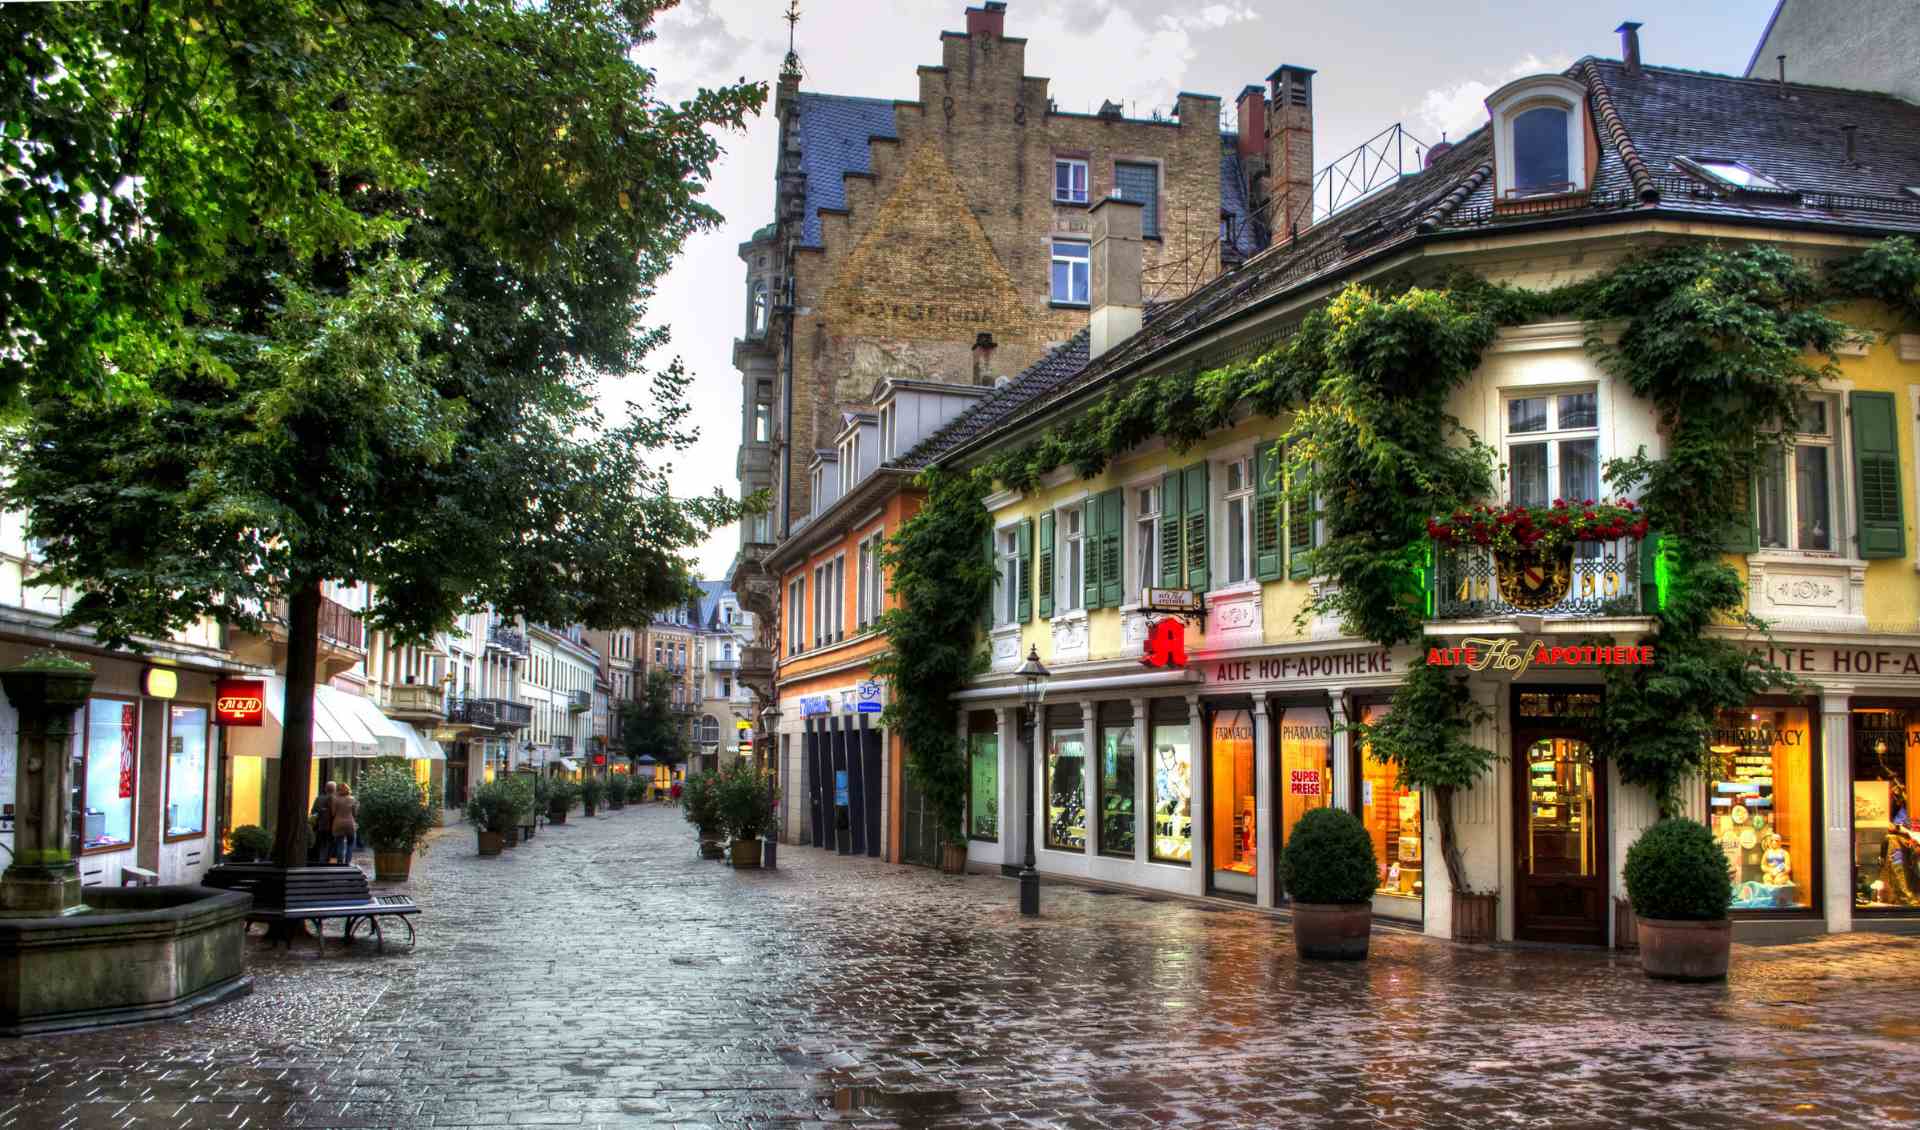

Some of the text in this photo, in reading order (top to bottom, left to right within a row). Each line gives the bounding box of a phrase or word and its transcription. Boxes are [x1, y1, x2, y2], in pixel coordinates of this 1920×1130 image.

[1217, 651, 1392, 681] ALTE HOF-APOTHEKE
[1426, 638, 1655, 680] ALTE Hof APOTHEKE
[1833, 650, 1920, 674] HOF-A
[1215, 727, 1253, 740] FARMACIA
[1718, 729, 1804, 746] PHARMACY
[1291, 770, 1320, 782] SUPER
[1291, 783, 1320, 795] PREISE
